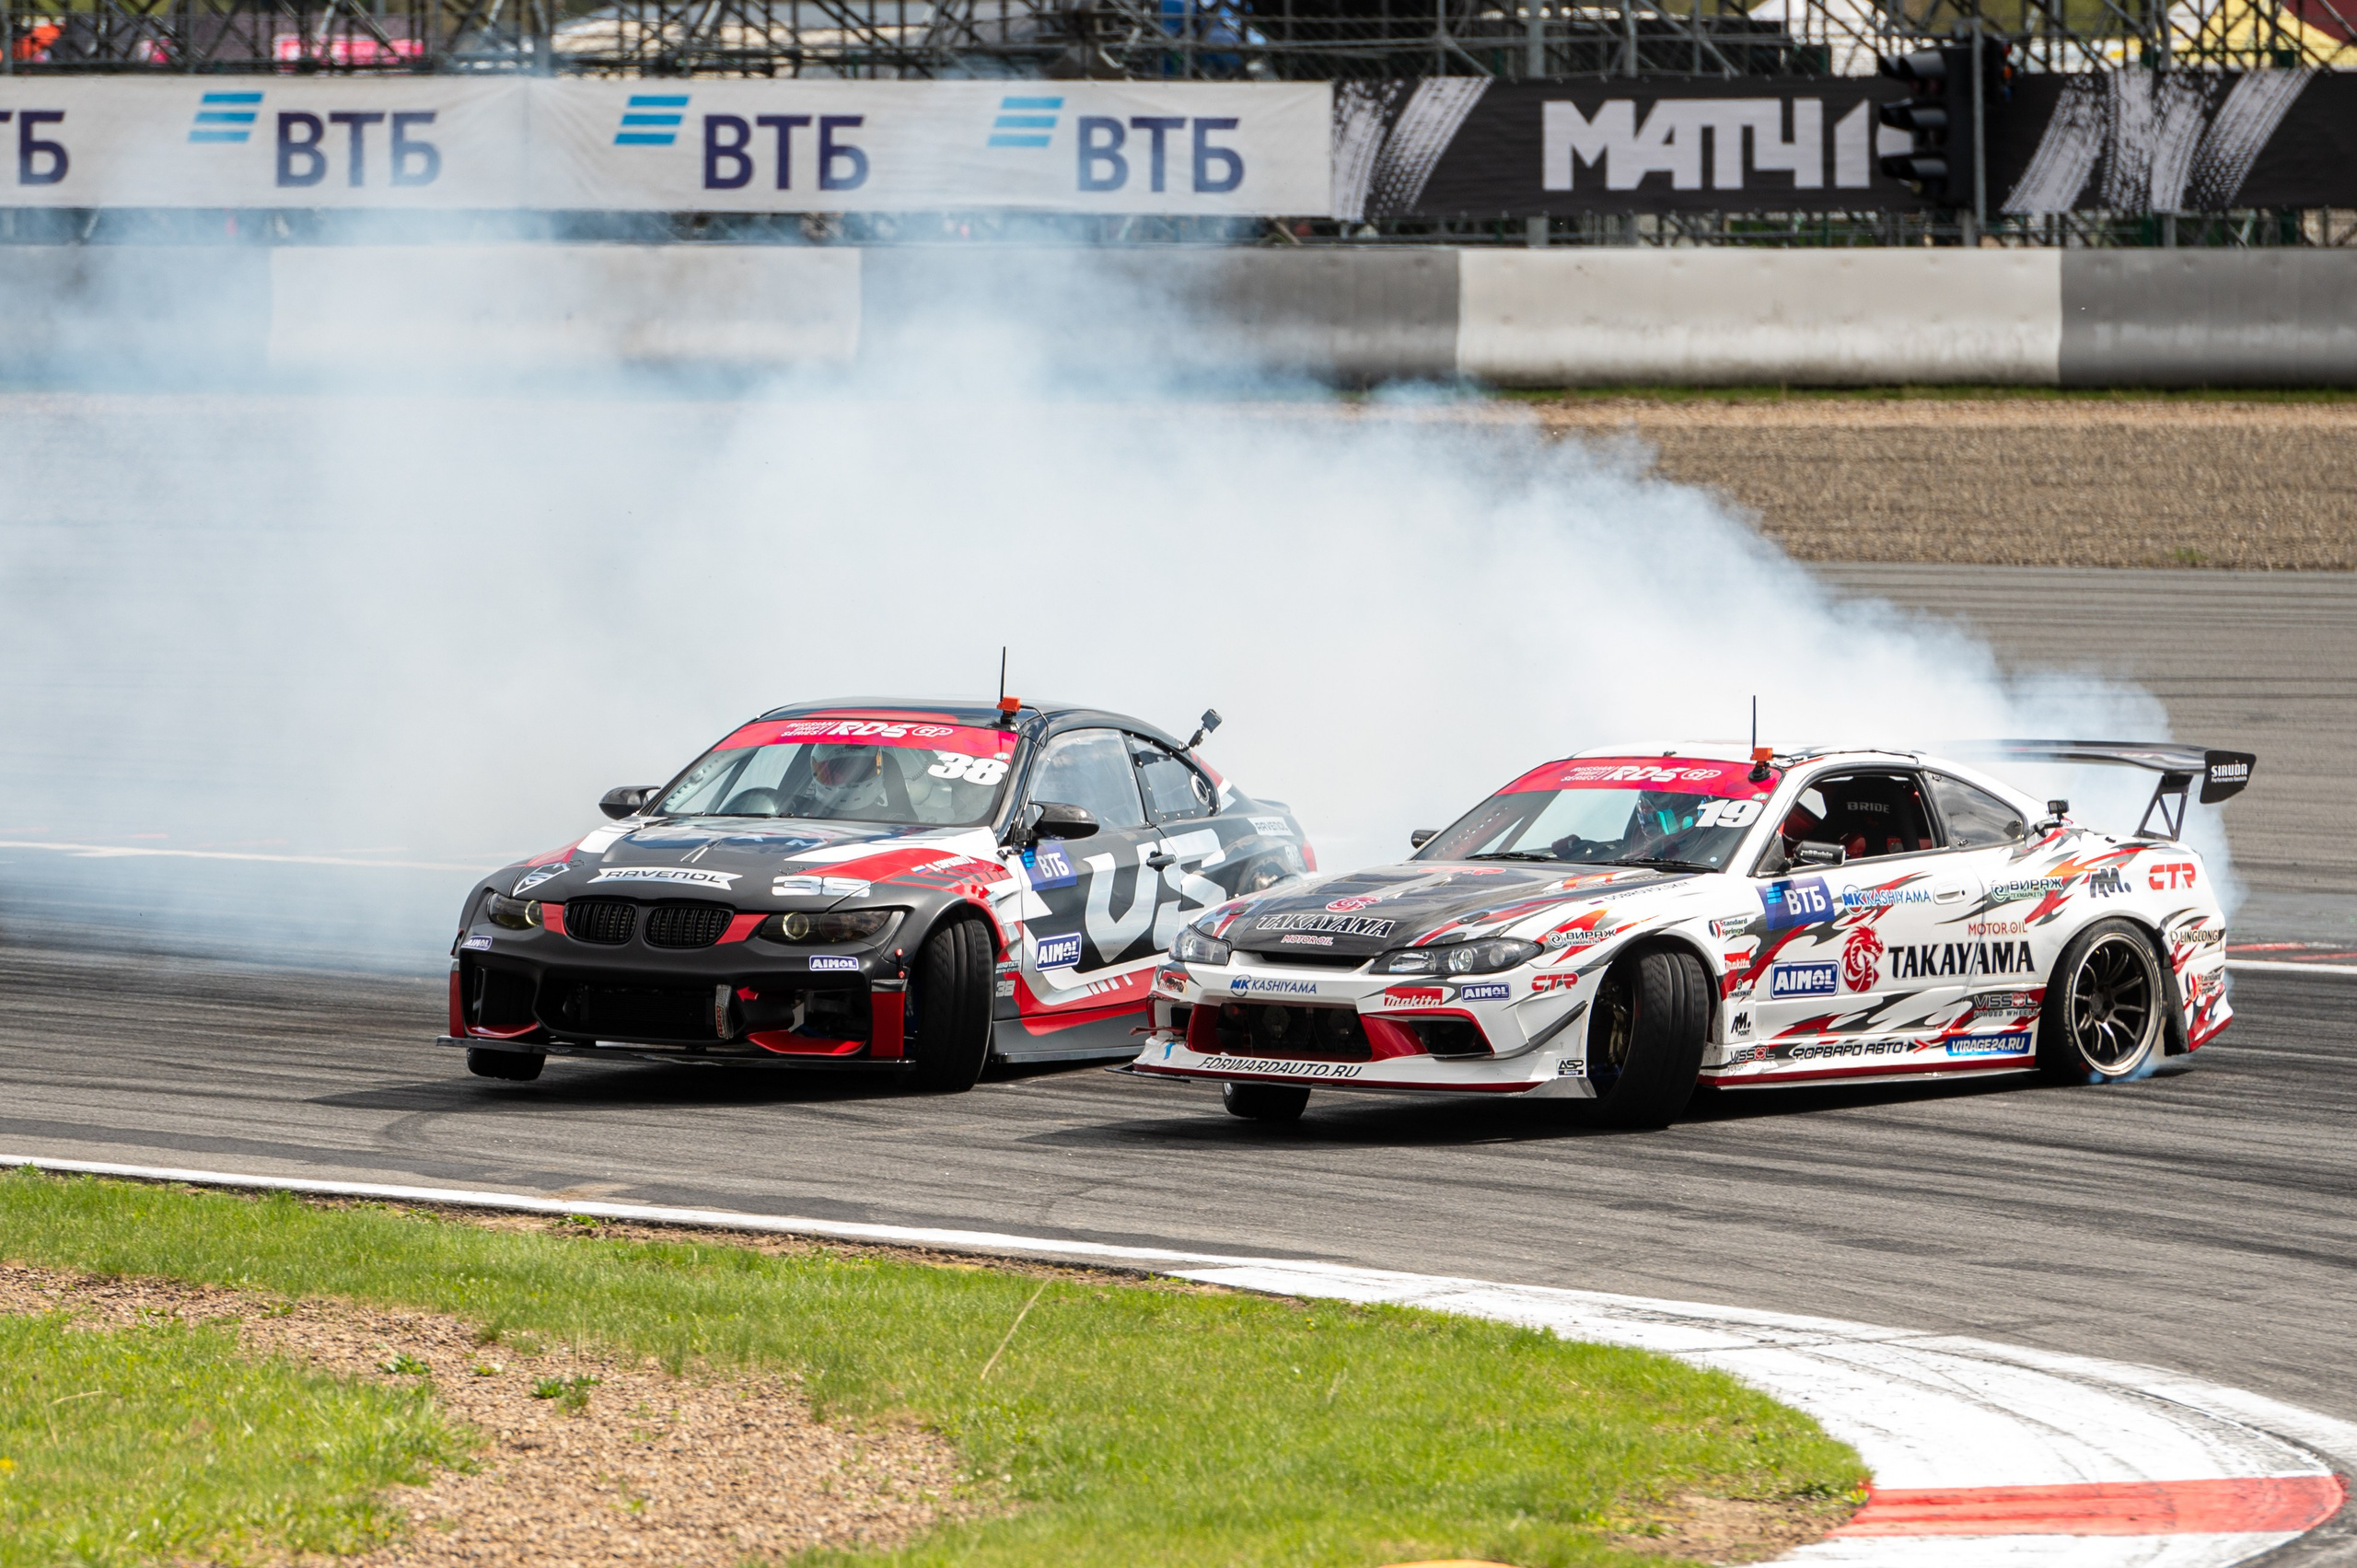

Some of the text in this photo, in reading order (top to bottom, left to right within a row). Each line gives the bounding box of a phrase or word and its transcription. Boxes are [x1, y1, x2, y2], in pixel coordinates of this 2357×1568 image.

[277, 111, 443, 188] ВТБ
[702, 114, 870, 192] ВТБ
[1076, 116, 1245, 193] ВТБ
[829, 721, 954, 738] RDS GP
[927, 751, 1010, 786] 38
[1602, 765, 1691, 783] RDS
[1695, 798, 1764, 828] 19
[1846, 801, 1890, 814] BRIDE
[1036, 852, 1070, 878] ВТБ
[605, 869, 721, 884] RAVENOL
[2009, 877, 2064, 891] ВИРАЖ
[2148, 862, 2197, 891] CTR
[772, 875, 872, 898] 38
[1783, 885, 1827, 916] ВТБ
[1840, 889, 1932, 907] MK KASHIYAMA
[1256, 913, 1396, 938] TAKAYAMA
[1719, 917, 1747, 927] Standard
[1968, 921, 2028, 935] MOTOR OIL
[1566, 929, 1617, 940] ВИРАЖ
[1721, 927, 1745, 936] Springs
[2179, 929, 2219, 943] LINGLONG
[463, 937, 491, 949] AIMOL
[1281, 934, 1334, 947] MOTOR OIL
[1037, 940, 1079, 965] AIMOL
[1887, 940, 2037, 979] TAKAYAMA
[811, 958, 856, 970] AIMOL
[995, 980, 1016, 998] 38
[1229, 979, 1318, 994] MK KASHIYAMA
[1531, 971, 1579, 992] CTR
[1774, 970, 1836, 993] AIMOL
[1463, 985, 1509, 999] AIMOL
[1973, 993, 2038, 1009] VISSOL
[2006, 1007, 2039, 1016] WHEELS
[1951, 1037, 2026, 1054] VIRAGE24.RU
[1197, 1056, 1364, 1078] FORWARDAUTO.RU
[1558, 1059, 1585, 1070] ASP
